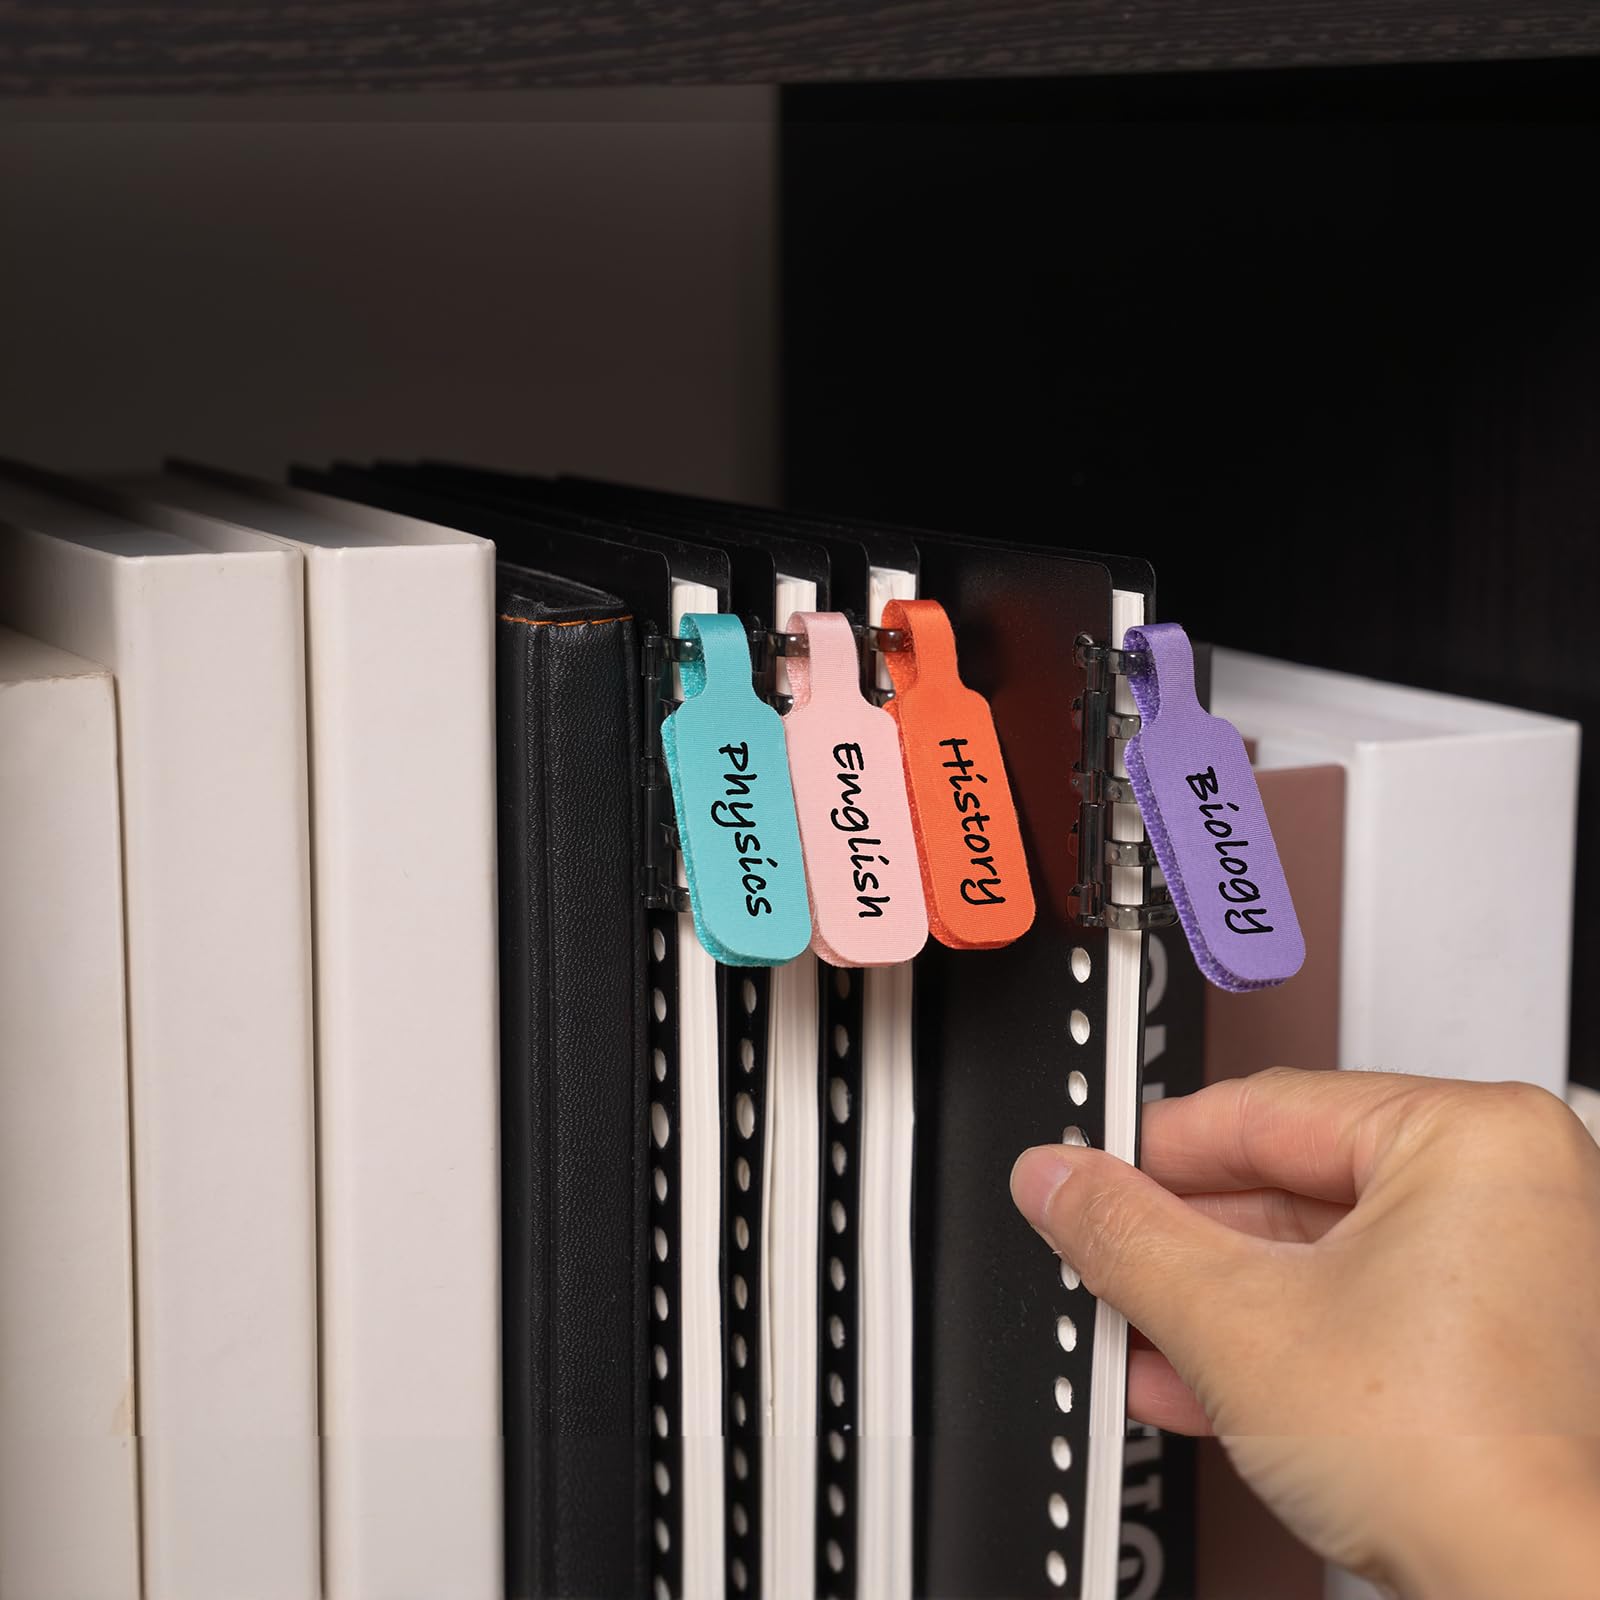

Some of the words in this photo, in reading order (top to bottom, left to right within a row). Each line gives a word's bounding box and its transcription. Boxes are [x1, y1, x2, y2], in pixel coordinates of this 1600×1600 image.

[711, 742, 778, 917] Physics
[830, 742, 891, 919] English
[938, 737, 1006, 905] History
[1186, 765, 1274, 934] Biology
